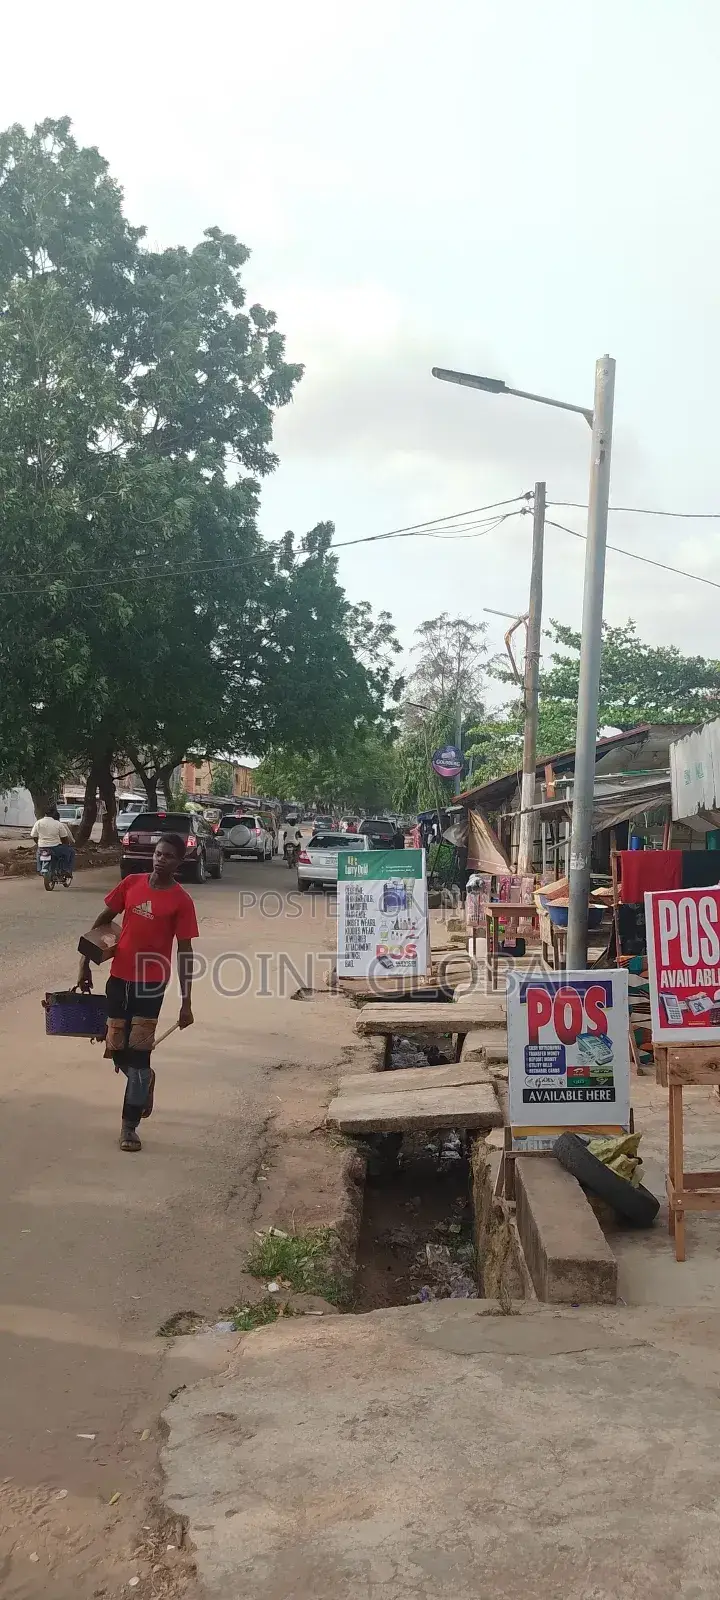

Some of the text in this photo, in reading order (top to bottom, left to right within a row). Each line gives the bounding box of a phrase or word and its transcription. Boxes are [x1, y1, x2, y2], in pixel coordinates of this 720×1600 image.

[657, 895, 720, 967] POS
[376, 944, 418, 960] POS
[660, 967, 720, 988] AVAILABL
[526, 985, 609, 1045] POS
[529, 1089, 611, 1101] AVAILABLE HERE
